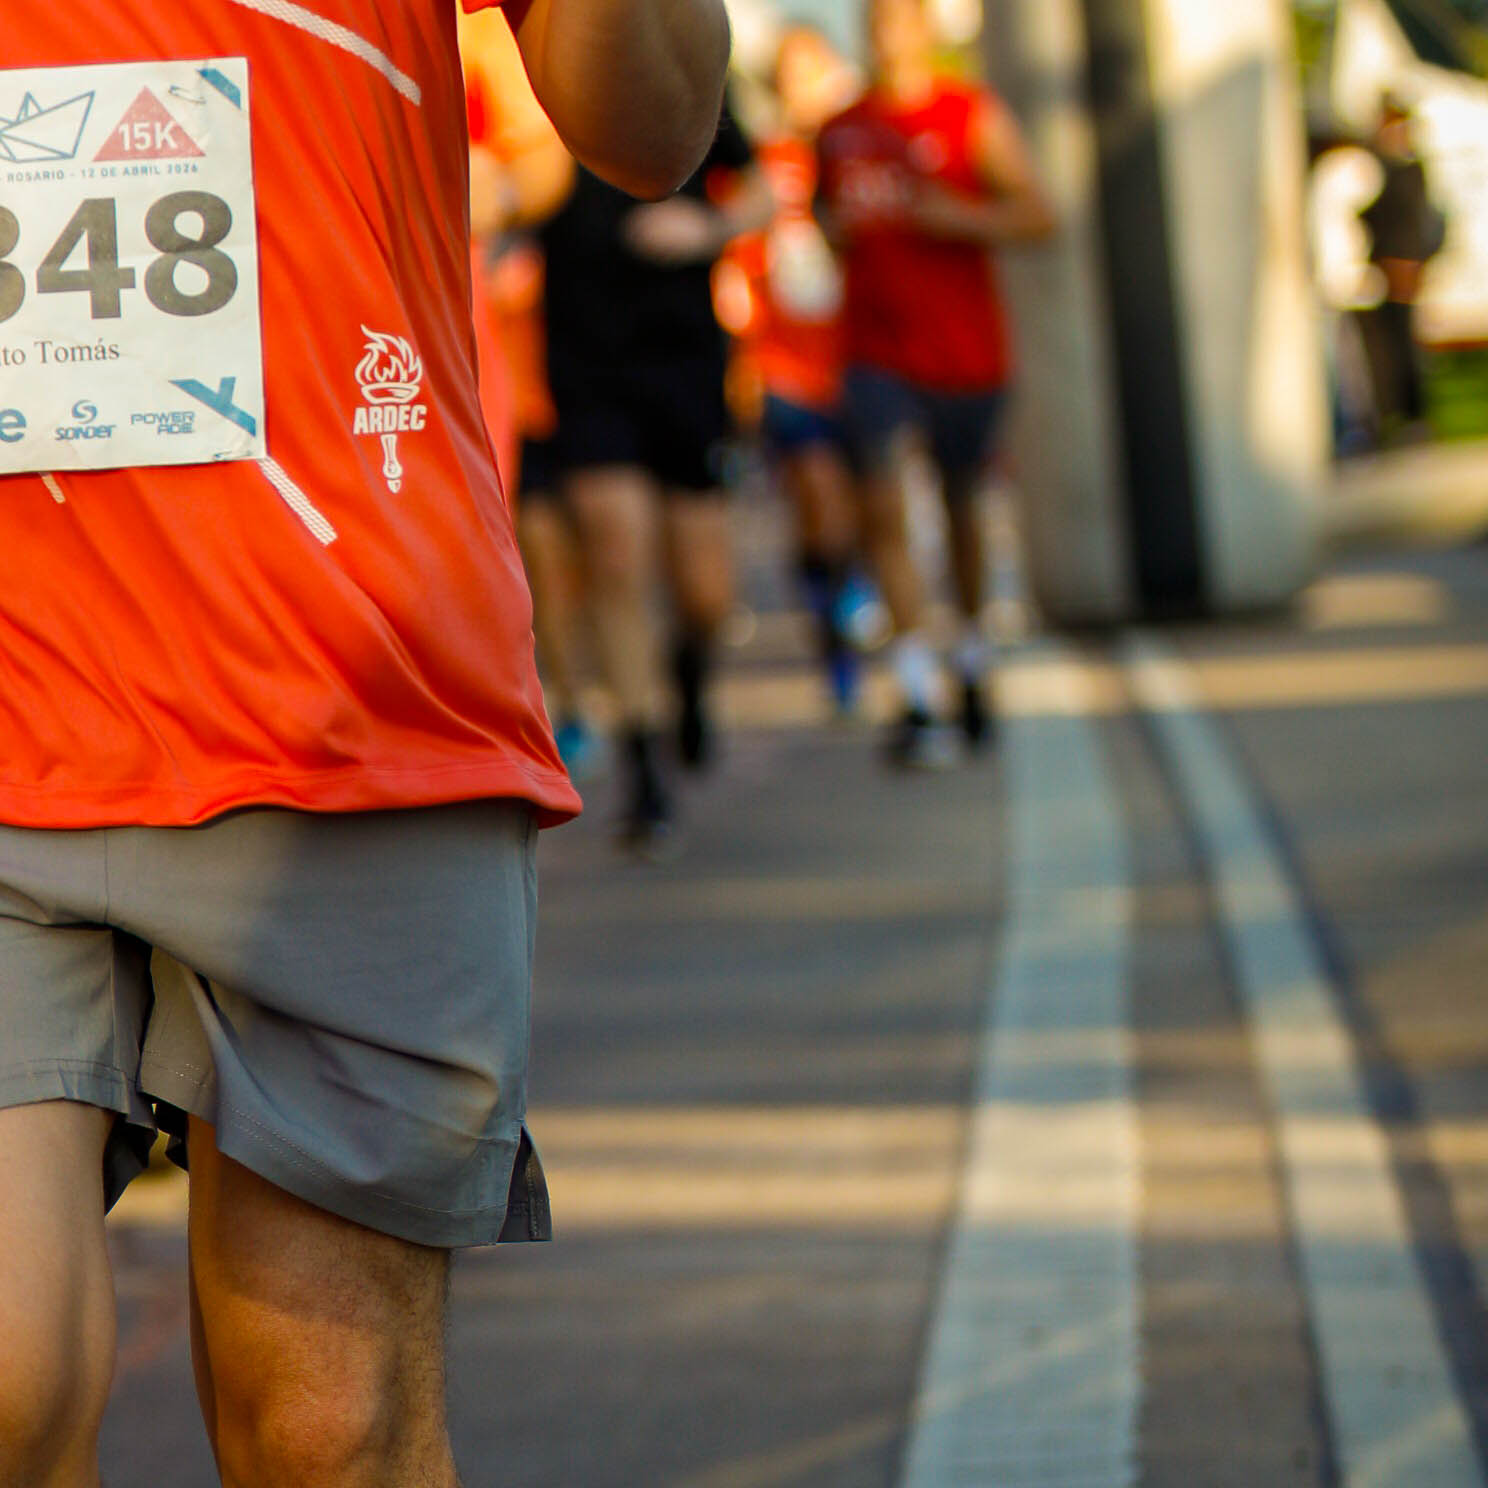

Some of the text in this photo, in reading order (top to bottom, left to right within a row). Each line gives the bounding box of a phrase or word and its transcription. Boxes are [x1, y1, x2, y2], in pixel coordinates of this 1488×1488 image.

[118, 120, 179, 152] 15K
[8, 170, 65, 183] ROSARIO
[82, 168, 95, 179] 12
[101, 167, 117, 178] DE
[122, 164, 161, 176] ABRIL
[167, 162, 198, 174] 2026
[33, 337, 120, 364] Tomás
[130, 410, 196, 425] POWER
[353, 405, 427, 435] ARDEC
